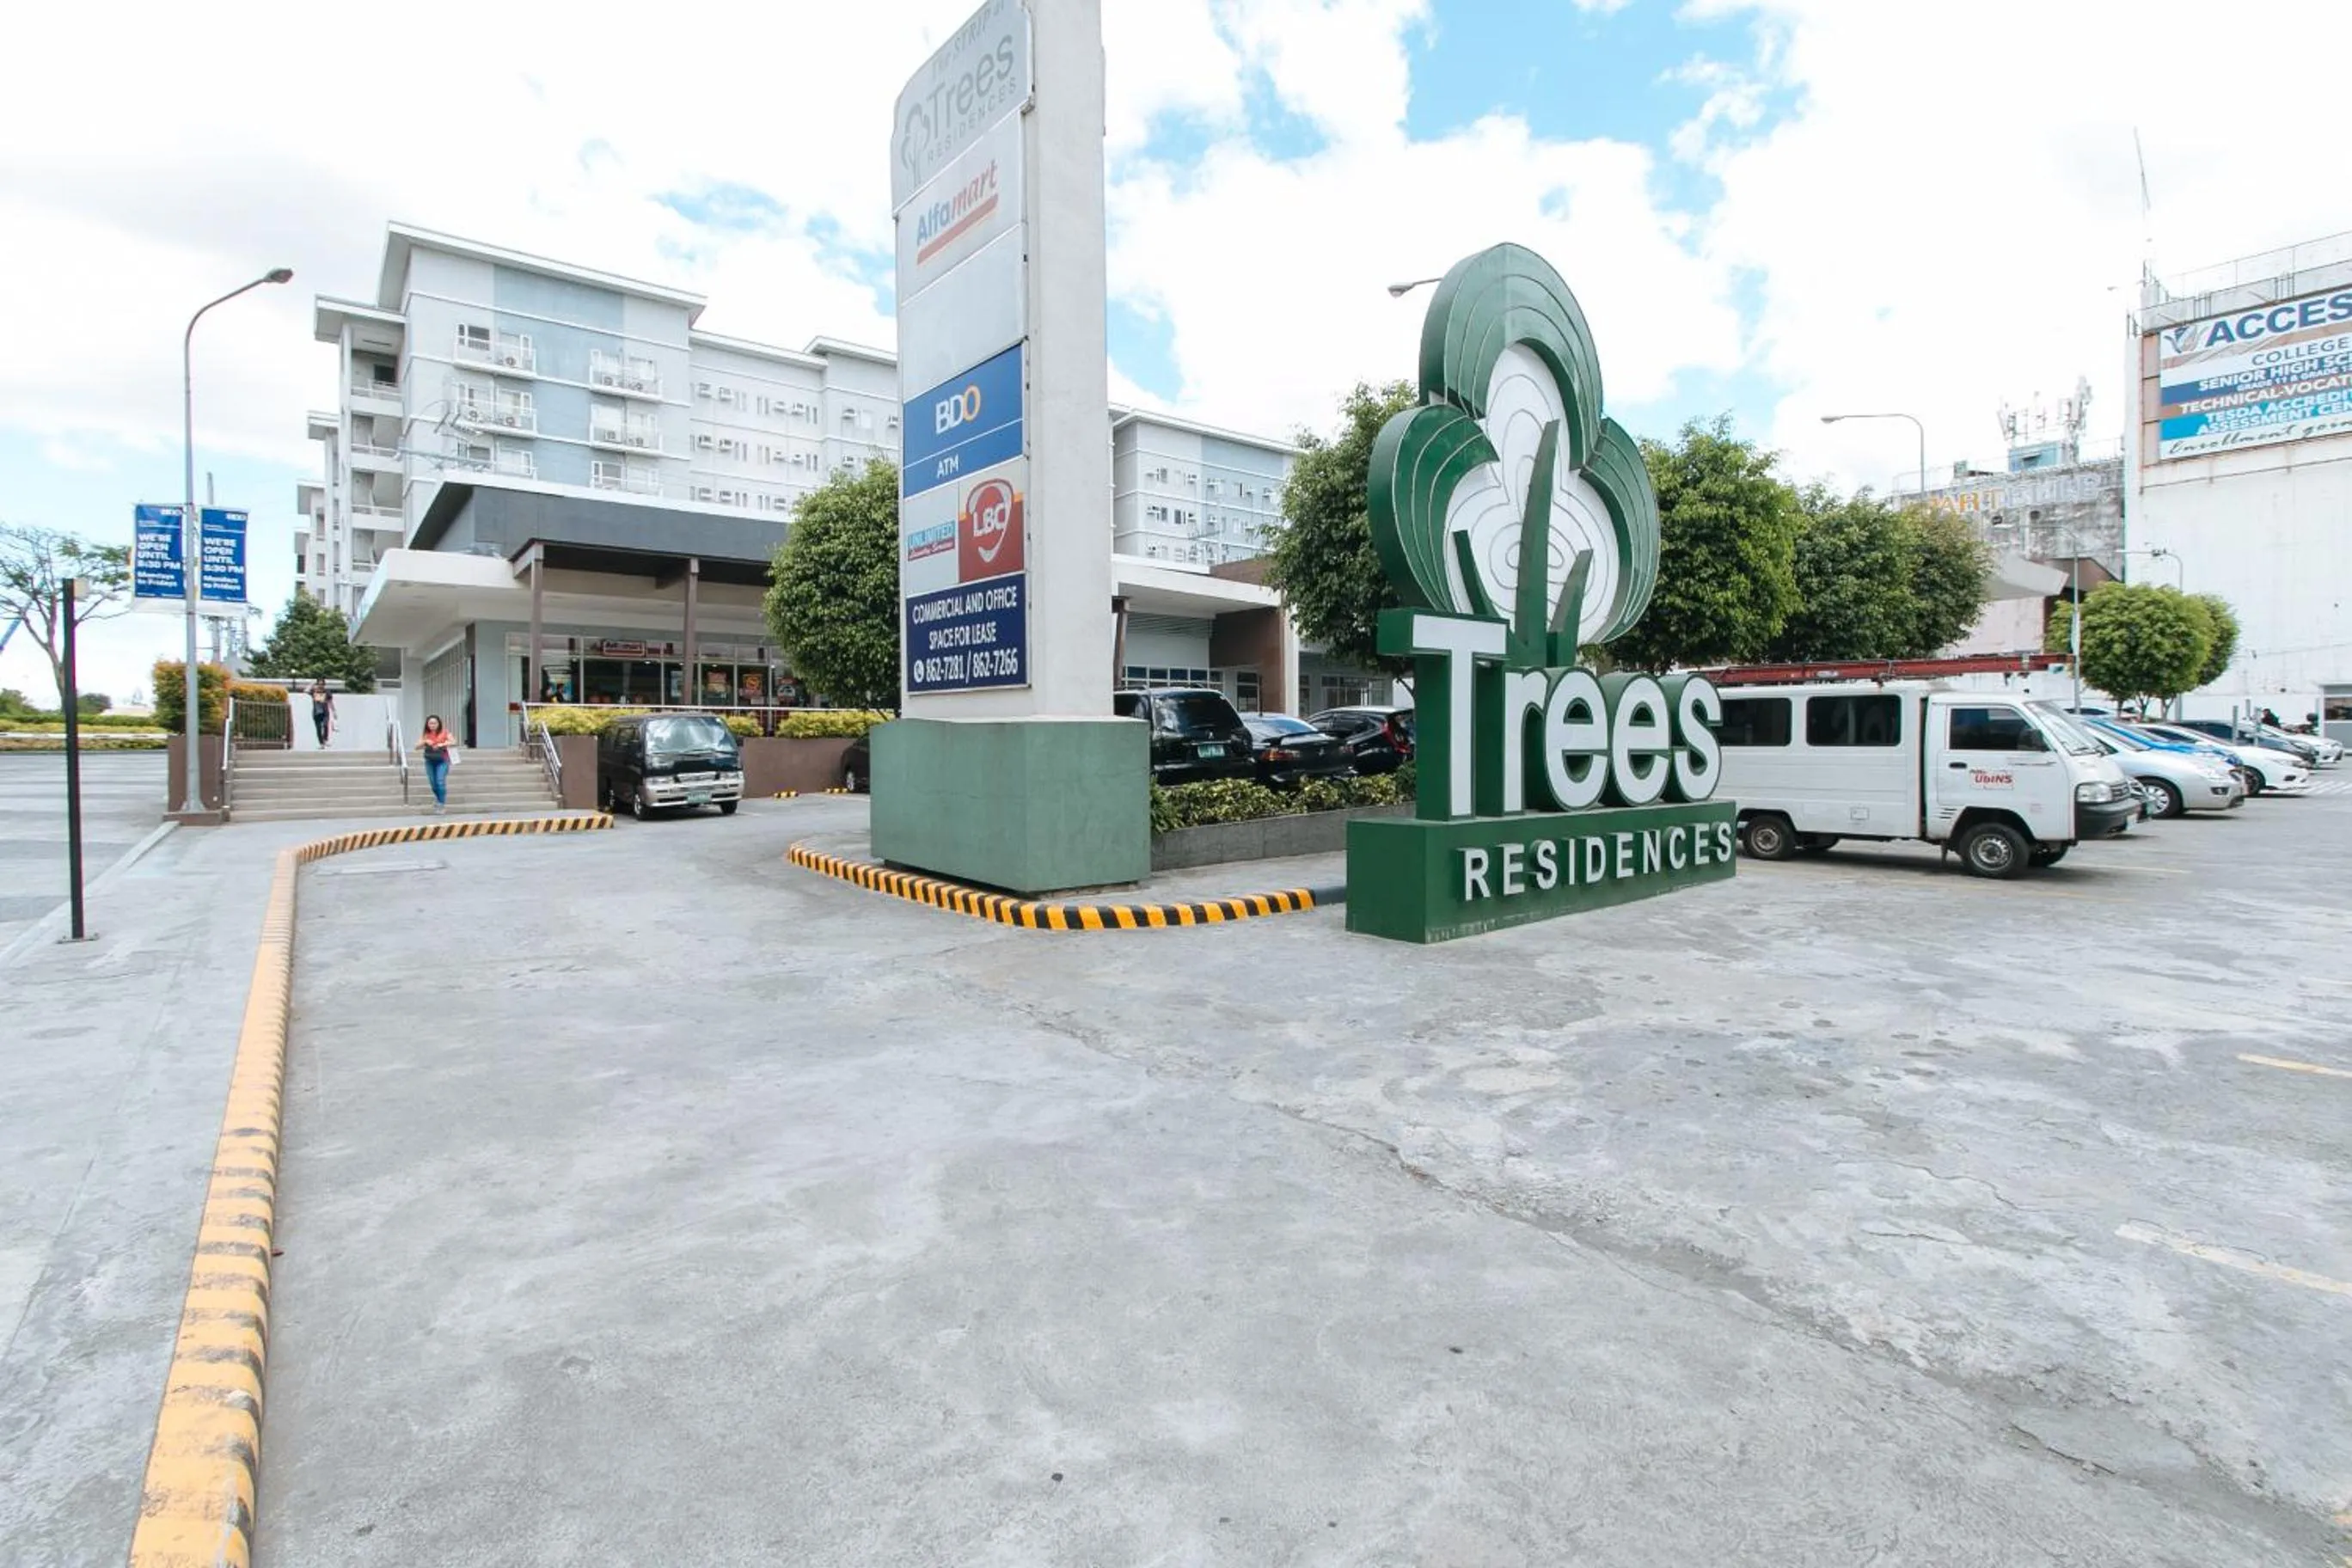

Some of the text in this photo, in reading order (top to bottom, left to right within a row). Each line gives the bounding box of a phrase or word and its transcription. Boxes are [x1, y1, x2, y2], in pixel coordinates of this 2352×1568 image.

[927, 34, 1014, 139] Trees
[928, 77, 1016, 162] RESIDENCES
[916, 159, 997, 246] Alfamart
[2204, 292, 2352, 347] ACCES
[2251, 336, 2349, 365] COLLEGE
[2198, 369, 2267, 391] SENIOR
[2269, 358, 2319, 378] HIGH
[935, 385, 981, 434] BDO
[2196, 407, 2312, 435] ASSESSMENT
[2205, 405, 2263, 424] TESDA
[937, 454, 959, 479] ATM
[972, 502, 1008, 538] LBC
[912, 585, 1017, 624] COMMERCIAL AND OFFICE
[929, 621, 996, 651] SPACE FOR LEASE
[1412, 613, 1723, 818] Trees
[1461, 821, 1732, 902] RESIDENCES
